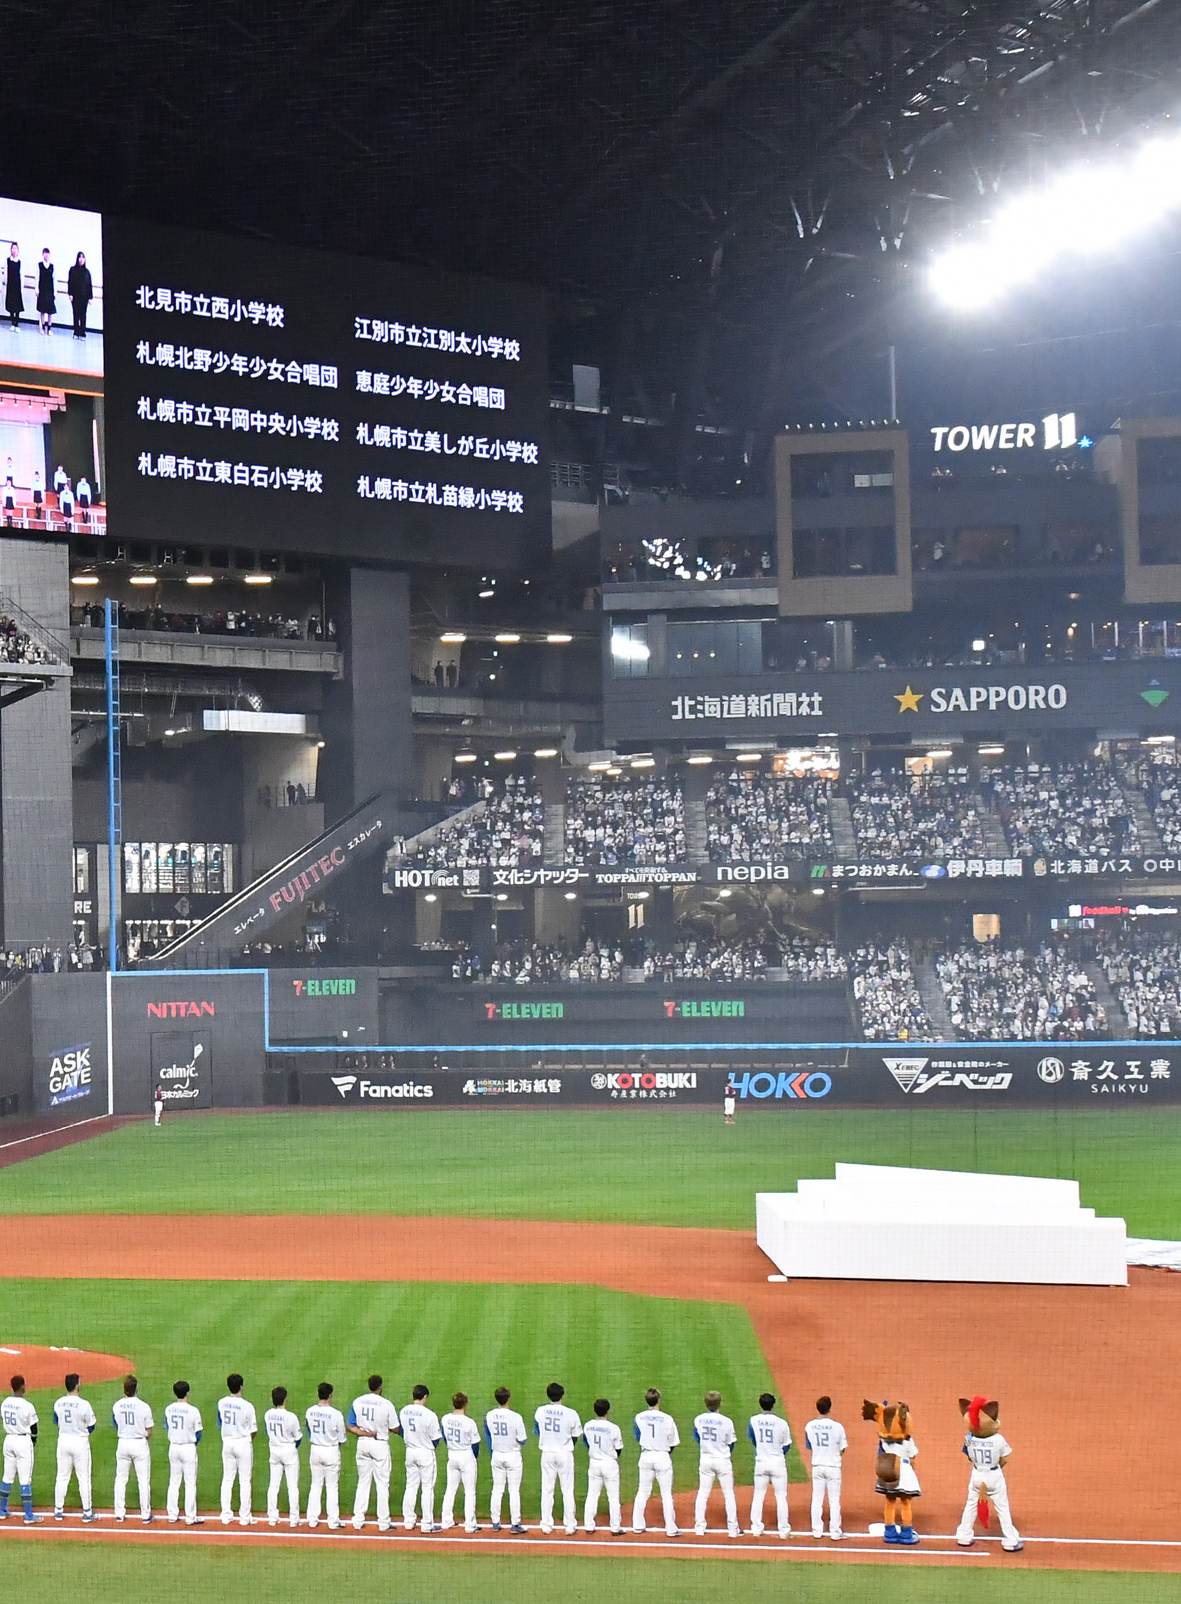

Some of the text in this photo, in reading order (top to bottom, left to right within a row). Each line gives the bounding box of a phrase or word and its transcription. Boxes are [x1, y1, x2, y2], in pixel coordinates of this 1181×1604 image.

[136, 285, 284, 328] 北見市立西小学校
[354, 317, 520, 360] 江別市立江別太小学校
[136, 341, 338, 388] 札幌北野少年少女合唱団
[355, 371, 505, 410] 恵庭少年少女合唱団
[137, 397, 339, 441] 札幌市立平岡中央小学校
[930, 412, 1078, 452] TOWER 11
[356, 423, 538, 464] 札幌市立美しが丘小学校
[138, 452, 323, 492] 札幌市立東白石小学校
[357, 476, 523, 513] 札幌市立札苗緑小学校
[930, 683, 1067, 712] SAPPORO
[671, 694, 823, 719] 北海道新聞社
[717, 862, 789, 882] nepia
[1050, 858, 1132, 874] 北海道バス
[1159, 858, 1181, 872] 中
[234, 820, 382, 935] エレベータ FUJITEC エスカレータ
[147, 1002, 215, 1018] NITTAN
[50, 1048, 91, 1078] ASK
[49, 1067, 91, 1093] GATE
[608, 1072, 697, 1089] KOTOBUKI
[728, 1072, 832, 1099] HOKKO
[912, 1071, 1013, 1093] ジーベック
[360, 1081, 434, 1098] Fanatics
[1091, 1084, 1149, 1093] SAIKYU
[4, 1411, 17, 1426] 66
[65, 1410, 71, 1423] 2
[121, 1411, 135, 1425] 70
[224, 1411, 236, 1425] 51
[361, 1407, 375, 1421] 41
[171, 1416, 184, 1430] 57
[269, 1423, 284, 1437] 47
[313, 1420, 325, 1434] 21
[409, 1419, 416, 1432] 5
[493, 1422, 507, 1436] 38
[545, 1417, 560, 1432] 26
[648, 1423, 655, 1438] 7
[447, 1428, 460, 1442] 29
[594, 1435, 601, 1449] 4
[702, 1426, 717, 1442] 25
[759, 1428, 773, 1443] 19
[815, 1432, 829, 1446] 12
[973, 1449, 992, 1464] 179
